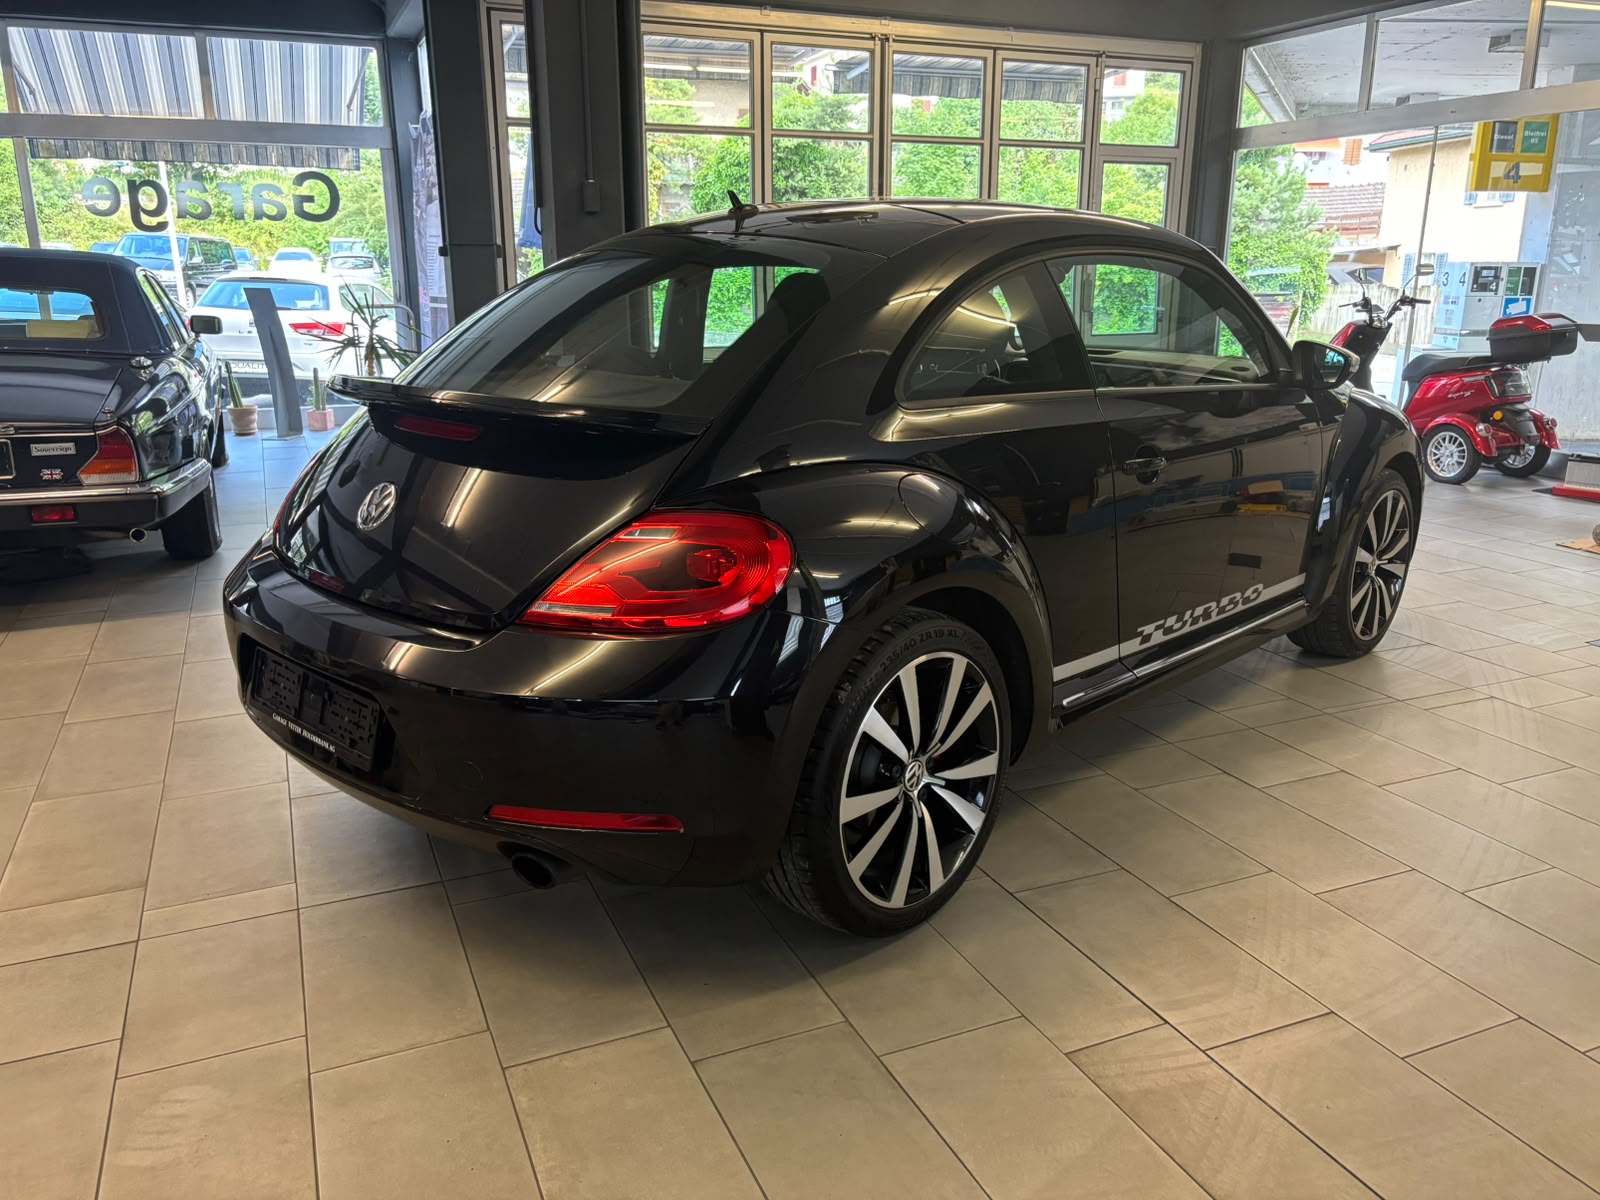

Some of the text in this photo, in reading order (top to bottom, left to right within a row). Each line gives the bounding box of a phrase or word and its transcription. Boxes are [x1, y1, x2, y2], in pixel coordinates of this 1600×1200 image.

[1503, 161, 1522, 184] 4
[1442, 272, 1467, 287] 3 4
[1489, 282, 1497, 291] 4
[230, 362, 265, 370] QUALIT
[1136, 583, 1264, 646] TURBO
[880, 629, 959, 671] 235/40 ZR 19 XL
